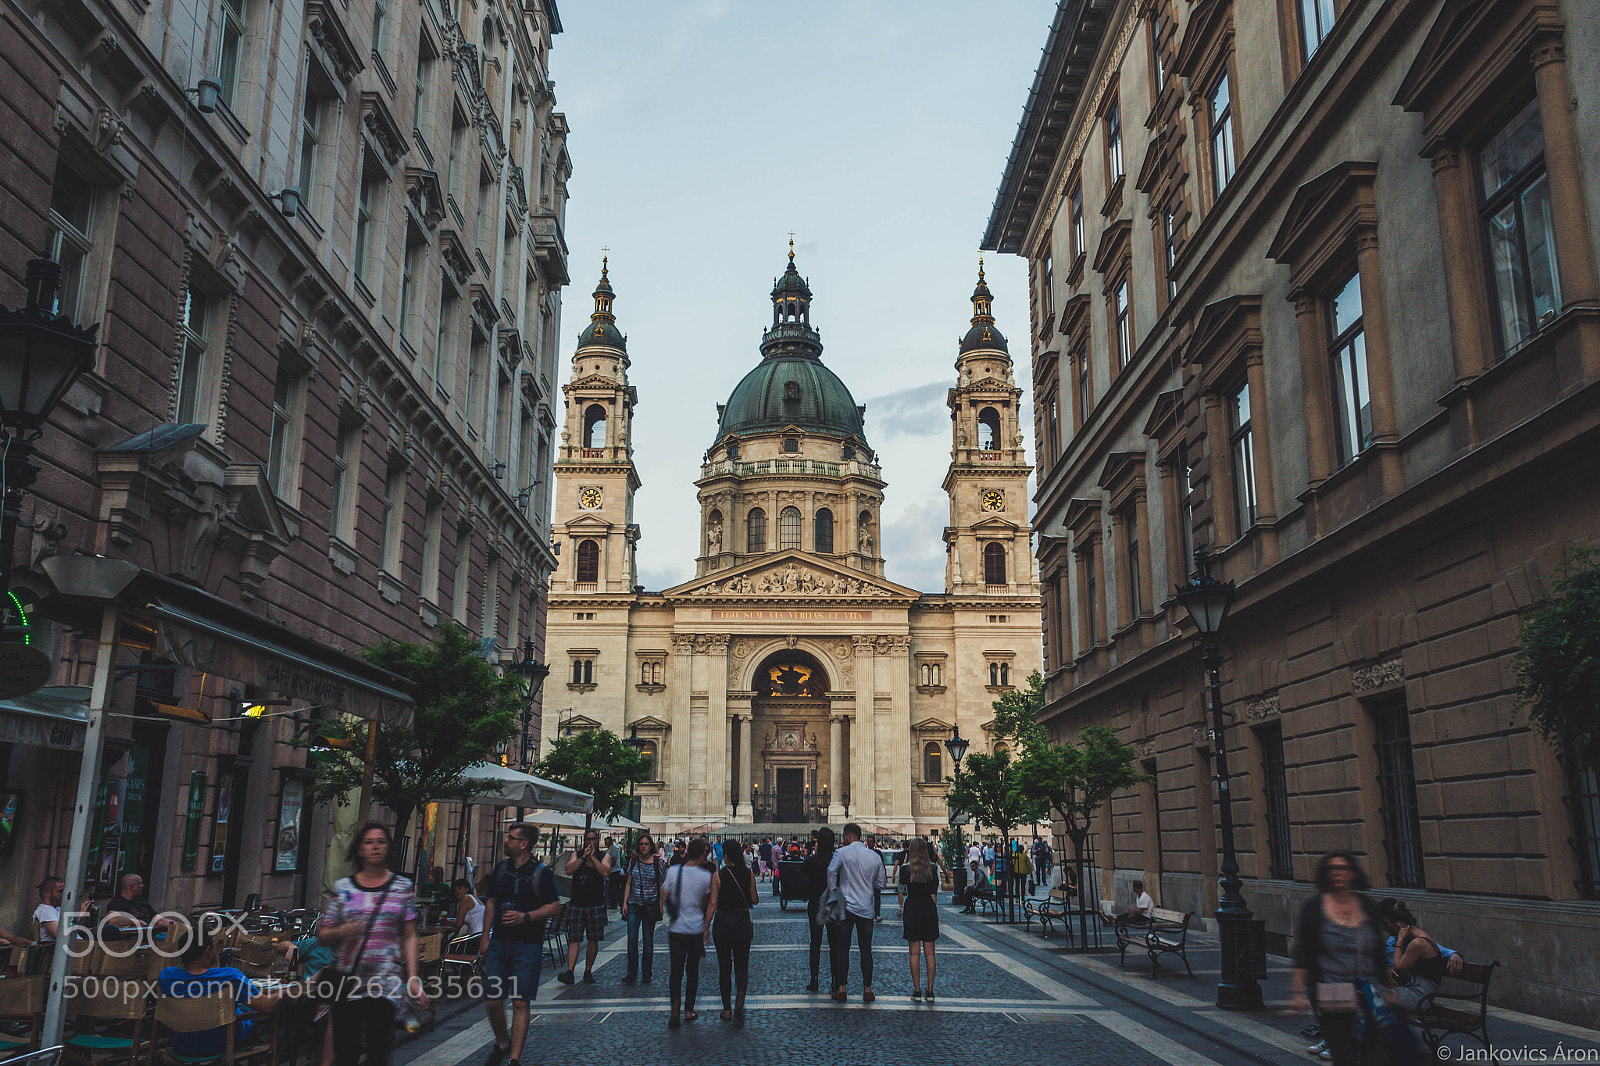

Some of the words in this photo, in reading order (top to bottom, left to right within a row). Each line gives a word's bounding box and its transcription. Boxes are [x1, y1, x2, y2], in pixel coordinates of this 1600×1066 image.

[720, 611, 739, 619] EGO
[743, 611, 763, 619] SUM
[769, 611, 784, 619] VIA
[788, 612, 824, 620] VERITAS
[828, 612, 839, 620] ET
[844, 612, 863, 620] VITA
[50, 724, 74, 747] Café
